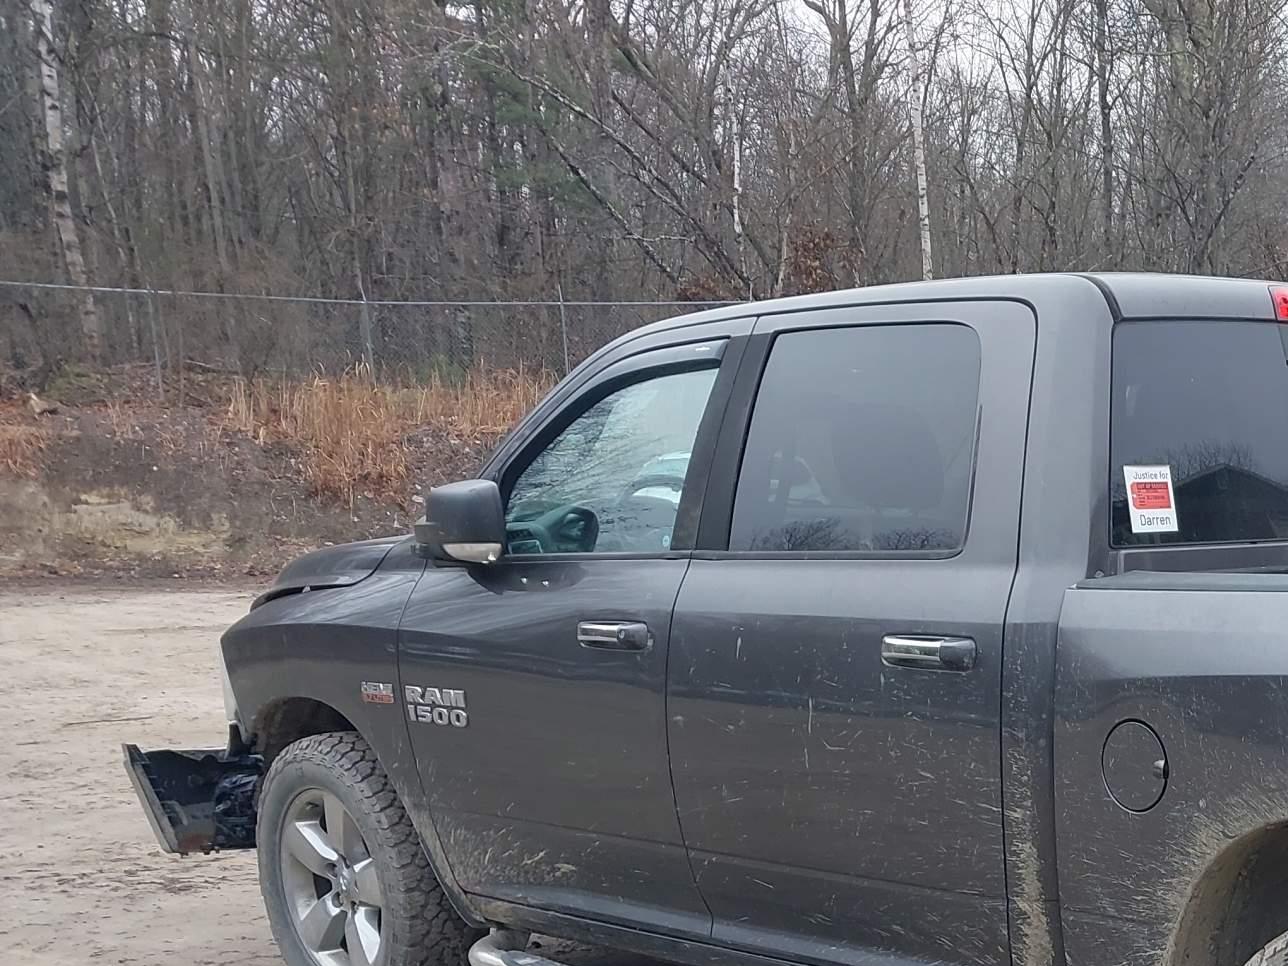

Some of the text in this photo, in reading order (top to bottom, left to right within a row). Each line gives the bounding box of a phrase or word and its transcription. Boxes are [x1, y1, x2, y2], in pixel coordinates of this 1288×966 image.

[1133, 471, 1168, 480] Justice for
[1140, 514, 1171, 527] Darren
[404, 685, 466, 708] RAM
[407, 704, 468, 728] 1500
